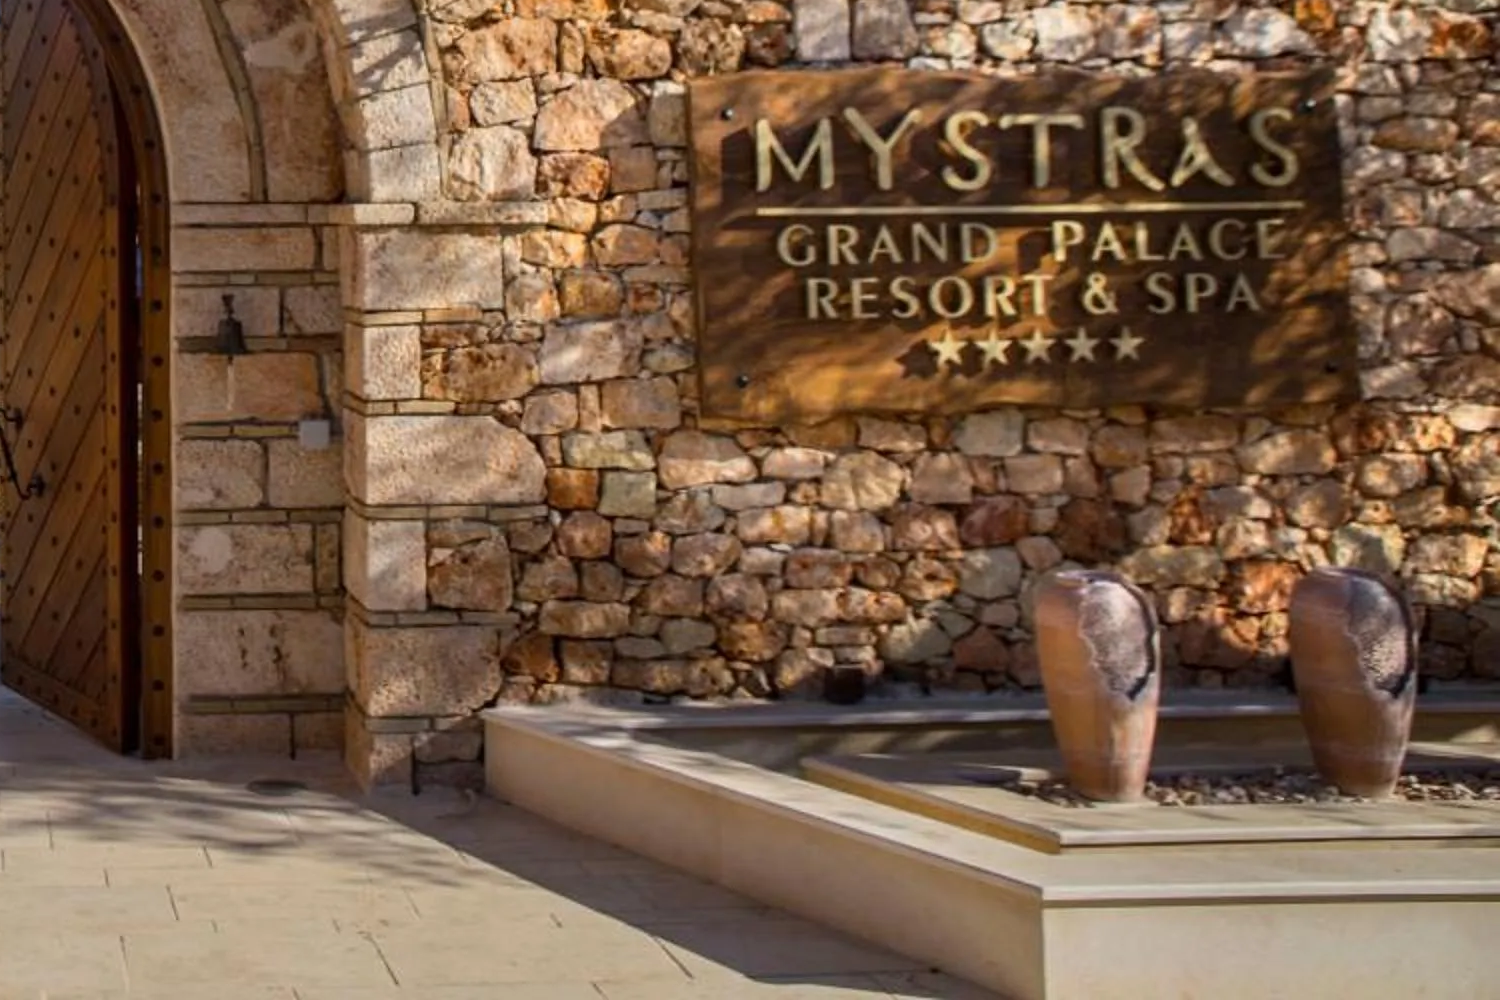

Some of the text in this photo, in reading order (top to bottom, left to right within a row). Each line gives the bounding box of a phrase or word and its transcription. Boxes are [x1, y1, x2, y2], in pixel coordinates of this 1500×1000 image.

[754, 106, 1299, 192] MYSTRAS
[776, 218, 1286, 268] GRAND PALACE
[807, 272, 1263, 320] RESORT & SPA
